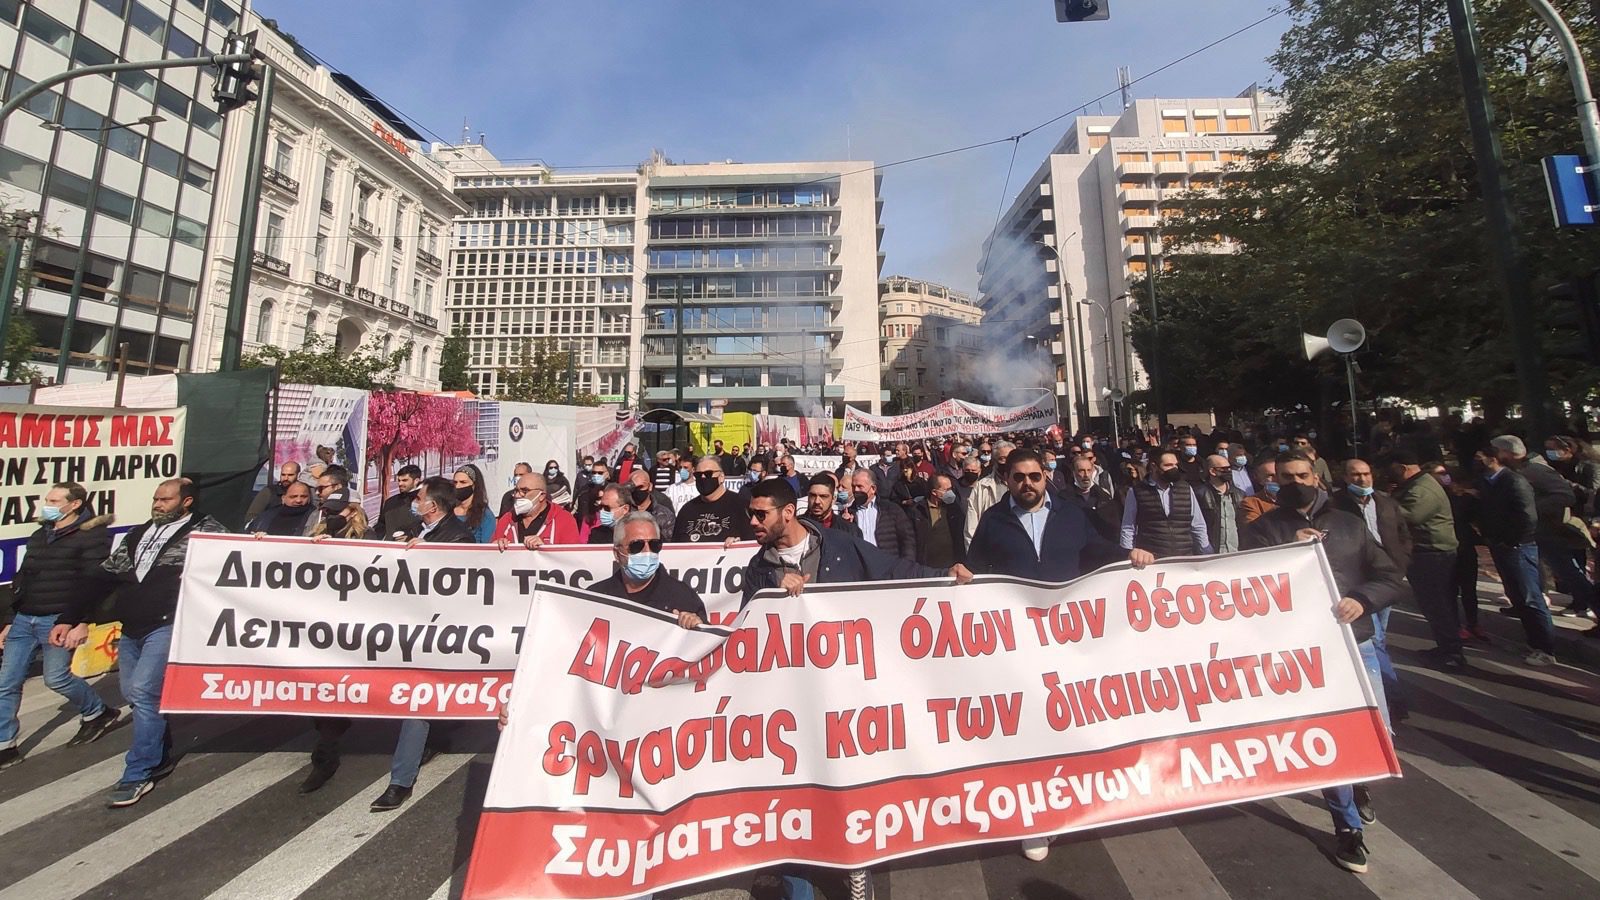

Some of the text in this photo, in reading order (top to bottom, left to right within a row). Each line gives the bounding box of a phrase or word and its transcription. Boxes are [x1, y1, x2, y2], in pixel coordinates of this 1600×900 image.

[1224, 136, 1272, 149] PLAZ
[110, 415, 175, 447] ΜΑΣ
[845, 421, 861, 433] ΚΑΤΩ
[33, 456, 86, 485] ΣΤΗ
[93, 453, 178, 482] ΛΑΡΚΟ
[803, 459, 837, 469] ΚΑΤΩ
[215, 550, 494, 605] Διασφάλιση
[900, 597, 1016, 660] όλων
[1026, 597, 1106, 647] των
[1126, 572, 1293, 632] θέσεων
[206, 608, 494, 664] Λειτουργίας
[200, 673, 369, 708] Σωματεία
[542, 643, 1326, 798] εργασίας και των δικαιωμάτων
[544, 727, 1339, 886] Σωματεία εργαζομένων ΛΑΡΚΟ
